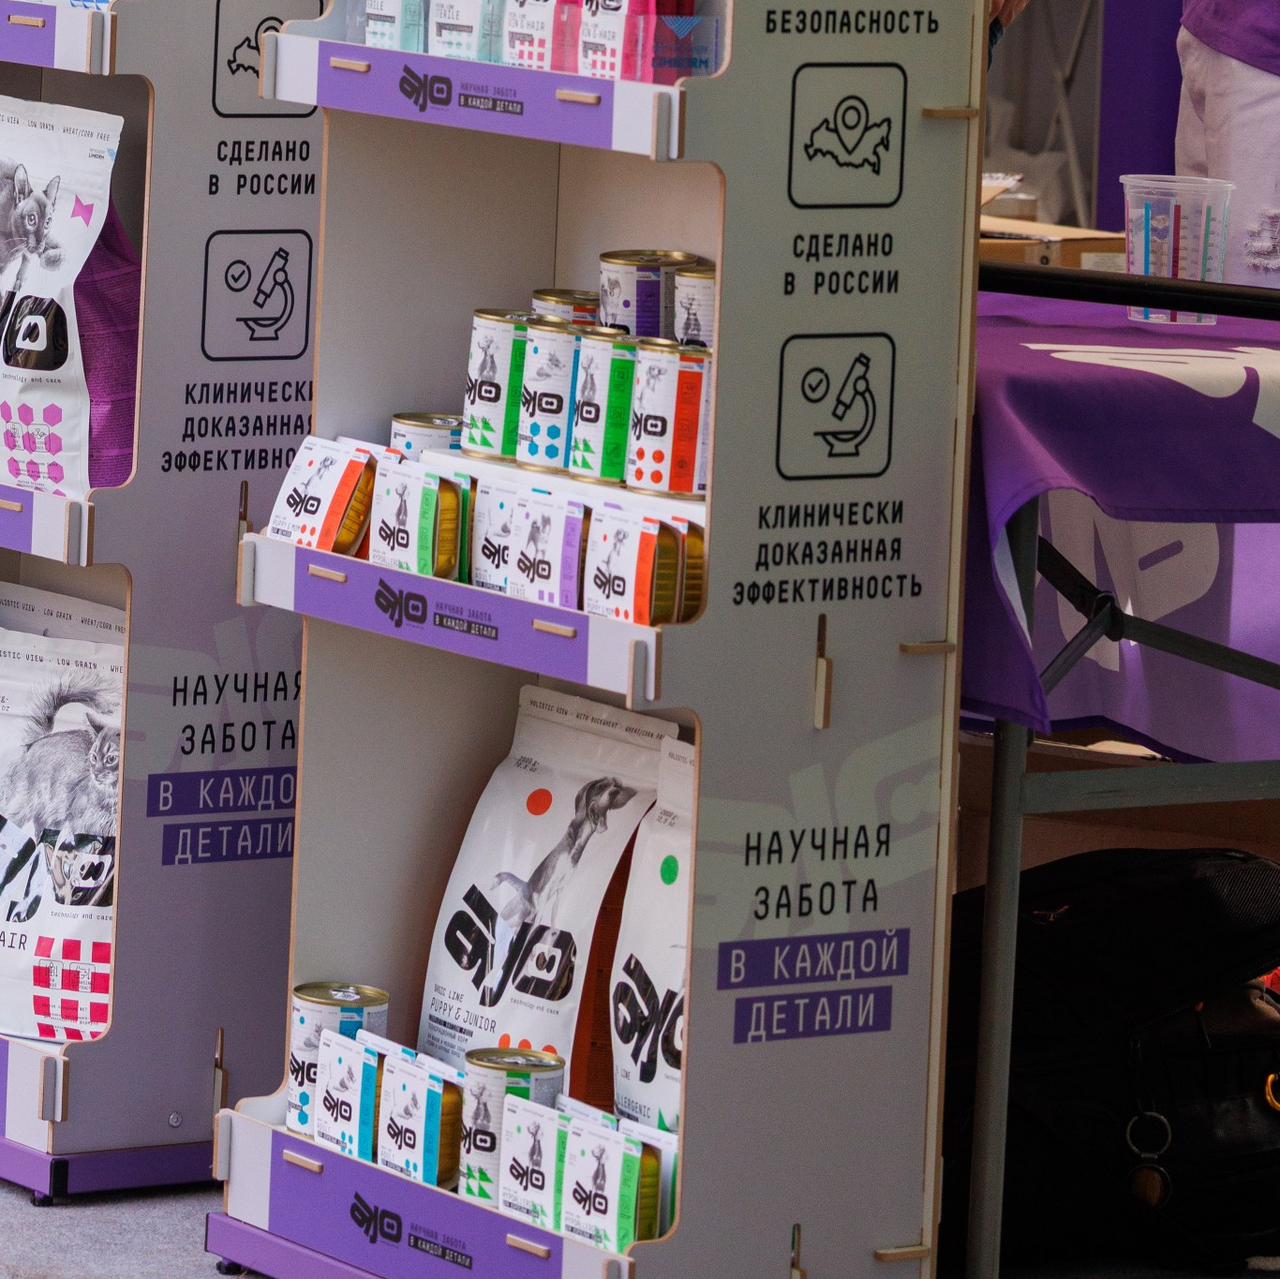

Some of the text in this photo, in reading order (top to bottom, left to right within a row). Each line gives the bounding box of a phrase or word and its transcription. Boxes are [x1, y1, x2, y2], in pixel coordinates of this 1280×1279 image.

[765, 9, 940, 35] БЕЗОПАСНОСТЬ
[7, 115, 19, 125] VIEW
[96, 132, 110, 141] FREE
[216, 139, 311, 166] СДЕЛАНО
[208, 171, 316, 198] В РОССИИ
[792, 233, 894, 262] СДЕЛАНО
[784, 269, 900, 296] В РОССИИ
[161, 447, 295, 472] ЭФФЕКТИВНО
[757, 500, 904, 530] КЛИНИЧЕСКИ
[755, 538, 902, 571] ДОКАЗАННАЯ
[732, 574, 922, 605] ЭФФЕКТИВНОСТЬ
[22, 604, 35, 613] VIEW
[43, 608, 53, 616] LOW
[55, 610, 72, 621] GRAIN
[25, 652, 44, 663] VIEW
[56, 657, 71, 666] LOW
[75, 658, 98, 670] GRAIN
[180, 719, 296, 755] ЗАБОТА
[159, 773, 294, 812] В КАЖДО
[175, 822, 293, 865] ДЕТАЛИ
[744, 823, 891, 867] НАУЧНАЯ
[753, 878, 879, 920] ЗАБОТА
[82, 912, 113, 921] and care
[730, 928, 898, 983] В КАЖДОЙ
[448, 989, 464, 1003] LINE
[430, 997, 497, 1033] PUPPY & JUNIOR
[748, 992, 875, 1042] ДЕТАЛИ
